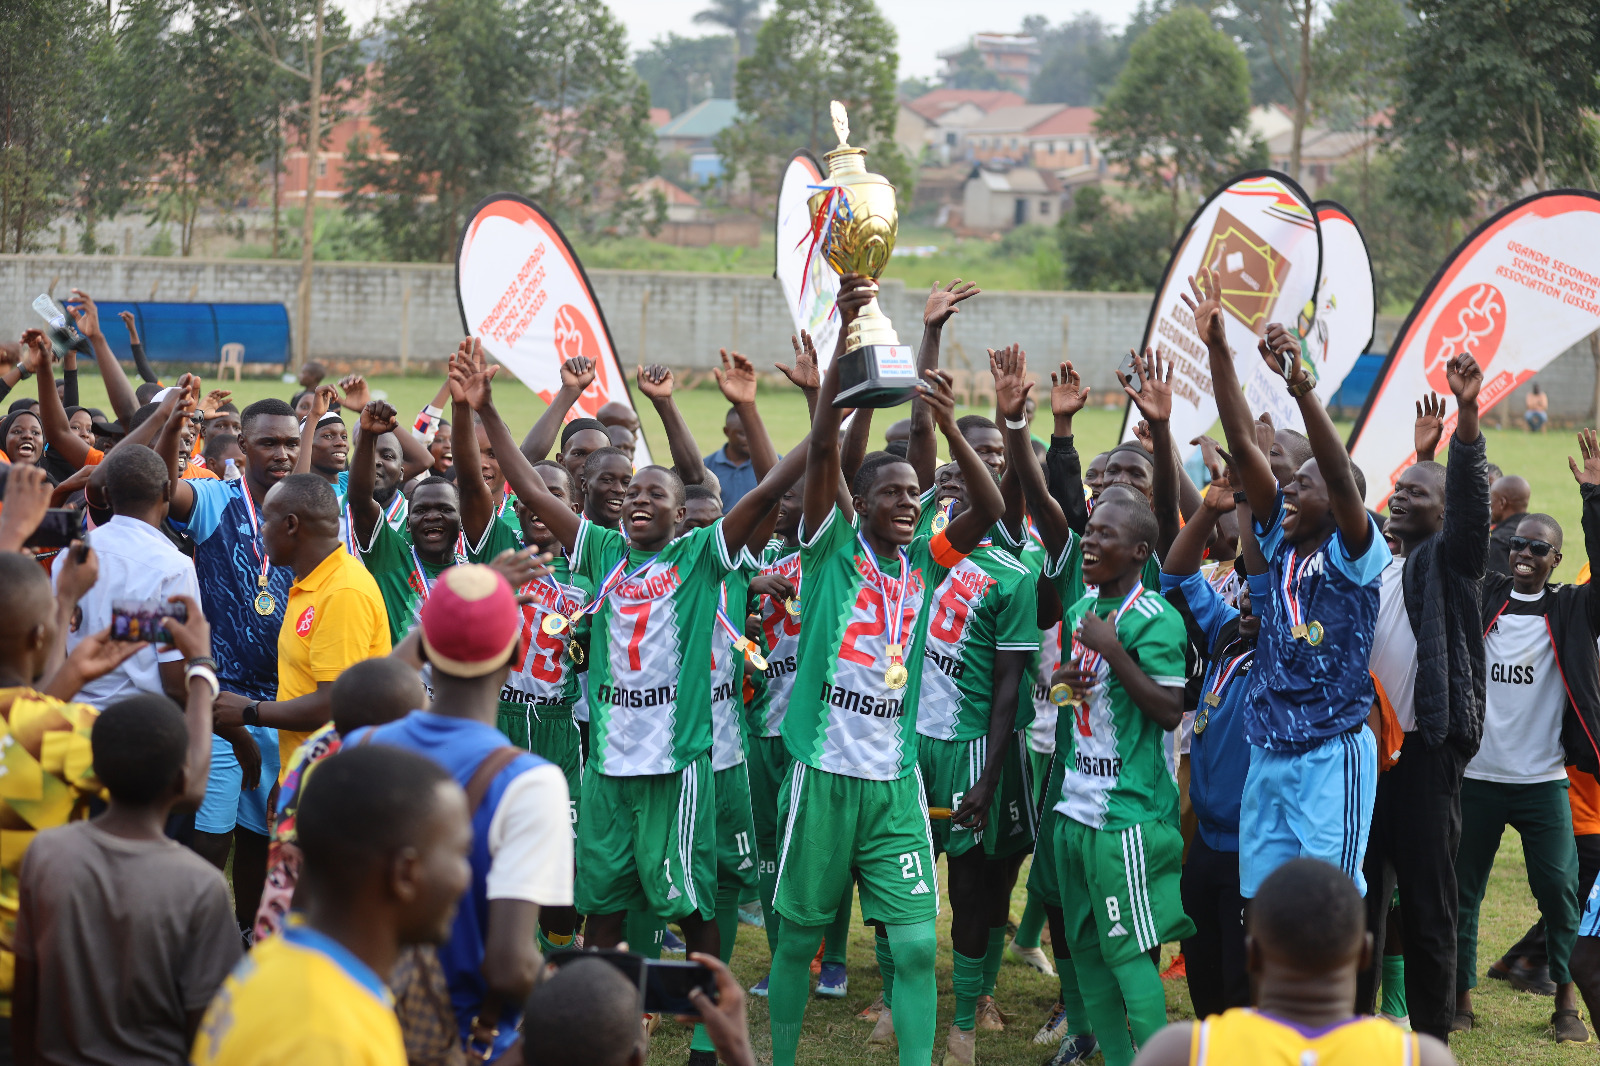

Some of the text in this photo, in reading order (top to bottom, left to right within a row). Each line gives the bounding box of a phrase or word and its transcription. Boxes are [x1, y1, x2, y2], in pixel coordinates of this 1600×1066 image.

[1507, 240, 1550, 266] UGANDA
[1495, 265, 1561, 299] ASSOCIATION
[1511, 257, 1597, 299] SCHOOLS SPORTS
[1158, 317, 1207, 365] SECONDARY
[930, 577, 976, 644] 6
[511, 604, 569, 684] 15
[620, 602, 652, 671] 7
[1491, 663, 1534, 685] GLISS
[1009, 799, 1020, 821] 5
[735, 831, 751, 856] 11
[760, 860, 776, 874] 20
[899, 851, 923, 879] 21
[1105, 896, 1120, 922] 8
[654, 930, 663, 943] 11
